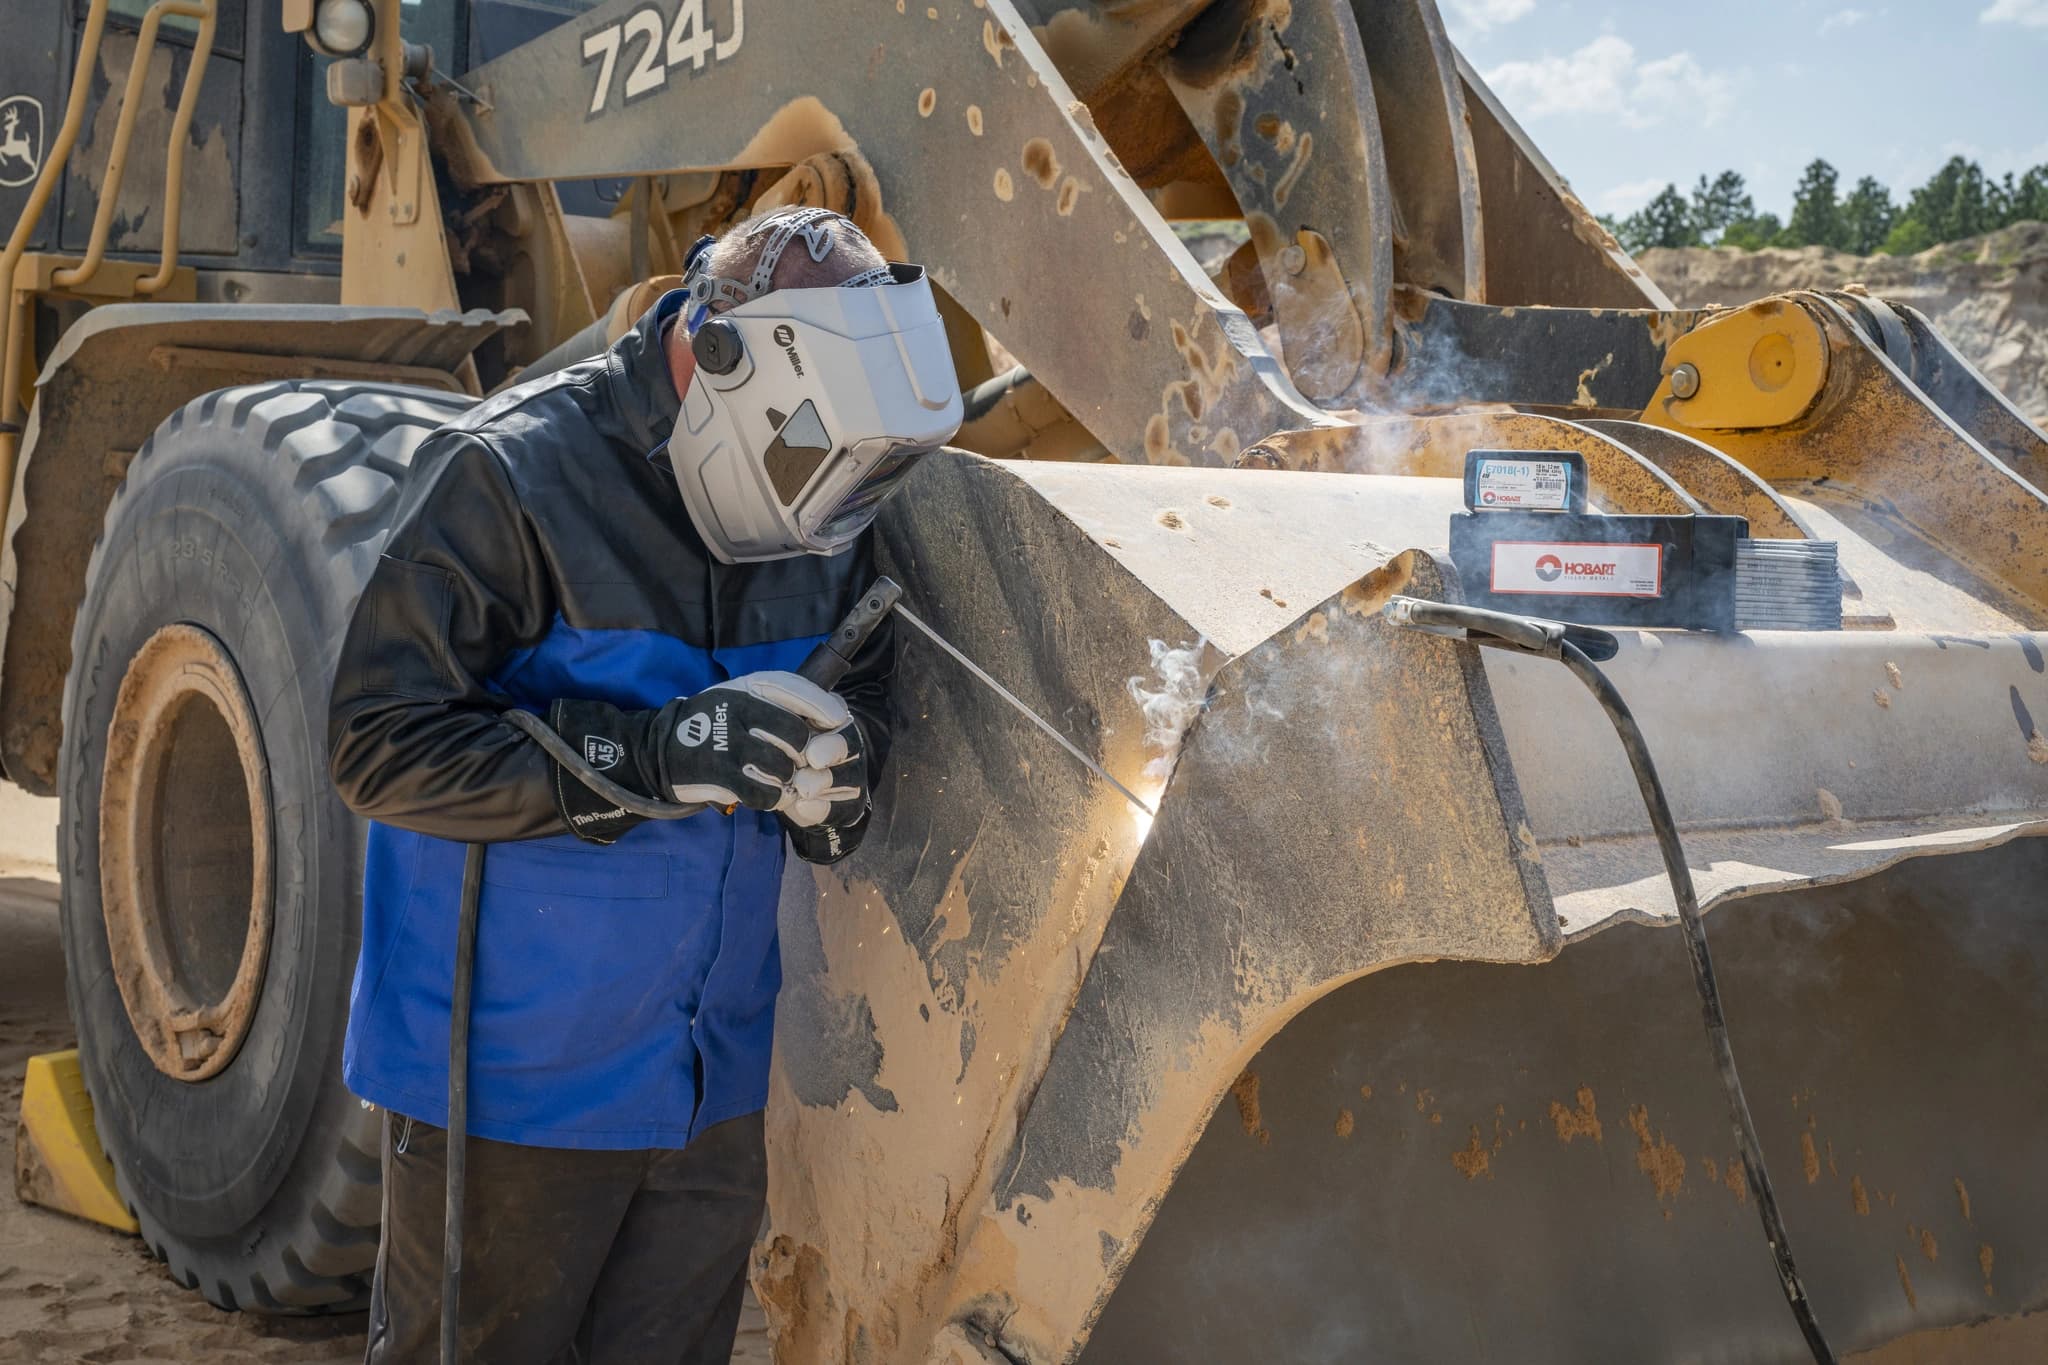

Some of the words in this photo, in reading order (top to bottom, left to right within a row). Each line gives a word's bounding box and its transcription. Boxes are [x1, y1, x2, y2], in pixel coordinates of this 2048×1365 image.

[582, 0, 745, 114] 724J
[1564, 562, 1616, 576] HOBART
[588, 742, 597, 764] ANSI
[597, 743, 615, 764] A5
[572, 813, 594, 826] The
[591, 807, 626, 821] Power
